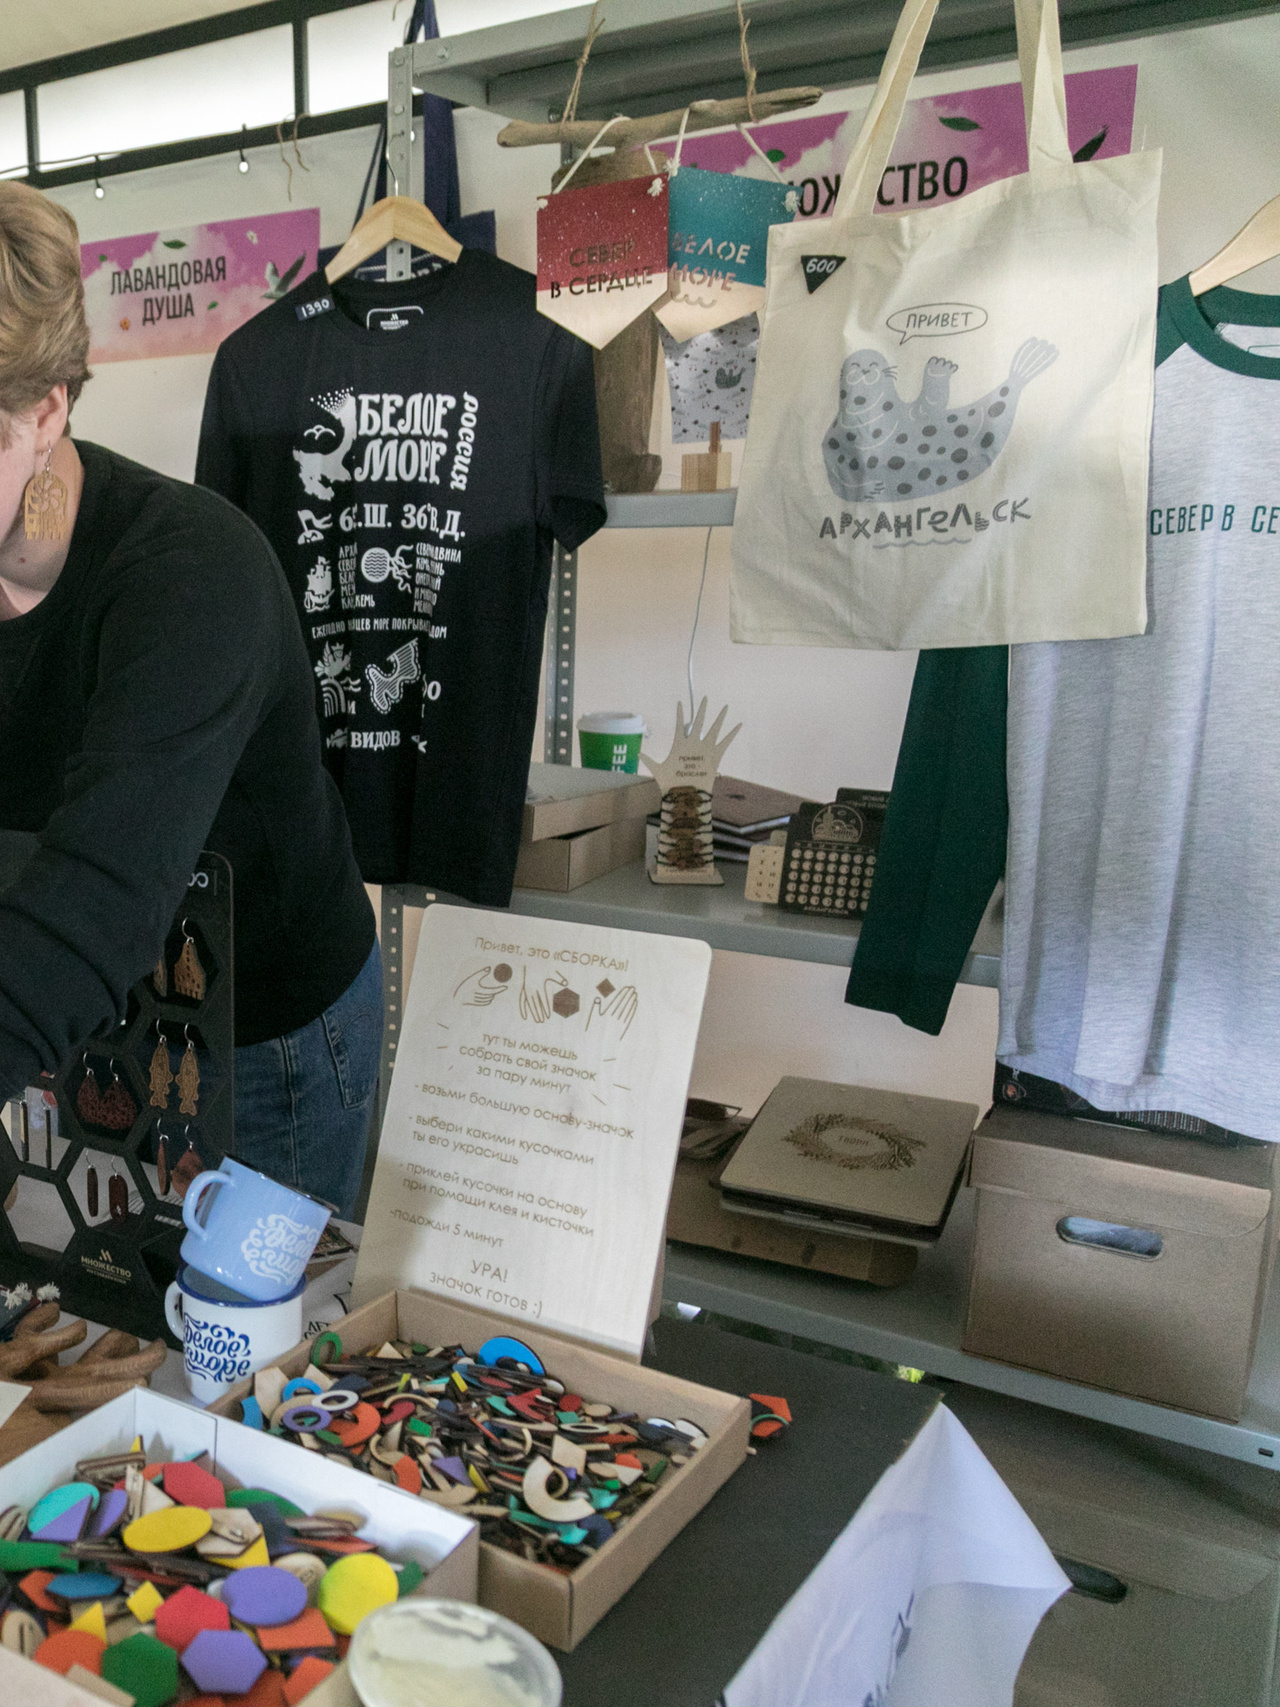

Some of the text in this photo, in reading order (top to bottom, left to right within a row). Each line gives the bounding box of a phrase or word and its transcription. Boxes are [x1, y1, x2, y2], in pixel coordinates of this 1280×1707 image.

[570, 240, 636, 267] СЕВЕР
[671, 231, 751, 265] БЕЛОЕ
[110, 256, 226, 295] ЛАВАНДОВАЯ
[550, 266, 653, 299] В СЕРДЦЕ
[671, 261, 736, 291] МОРЕ
[806, 258, 837, 274] 600
[142, 293, 195, 326] ДУША
[302, 299, 329, 318] 1390
[906, 312, 973, 329] ПРИВЕТ
[358, 392, 456, 438] БЕЛОЕ
[450, 391, 478, 491] россия
[354, 438, 447, 485] МОРЕ
[819, 497, 1032, 539] АРХАНГЕЛЬСК
[1150, 504, 1213, 535] СЕВЕР
[1221, 505, 1235, 531] В
[374, 618, 389, 630] МОРЕ
[351, 730, 401, 751] ВИДОВ
[475, 938, 523, 955] Привет,
[528, 948, 550, 959] это
[460, 1045, 596, 1081] собрать свой значок
[483, 1034, 577, 1060] тут ты можешь
[477, 1066, 571, 1093] за пару минут
[422, 1084, 634, 1139] возьми большую основу-значок
[413, 1130, 519, 1164] ты его украсишь
[416, 1115, 594, 1164] выбери какими кусочками
[403, 1178, 594, 1236] при помощи клея и кисточки
[407, 1163, 588, 1218] приклей кусочки на основу
[453, 1224, 460, 1235] 5
[464, 1230, 503, 1247] минут
[81, 1256, 131, 1278] МНОЖЕСТВО
[471, 1260, 508, 1283] УРА!
[429, 1273, 483, 1297] значок
[487, 1290, 527, 1310] готов
